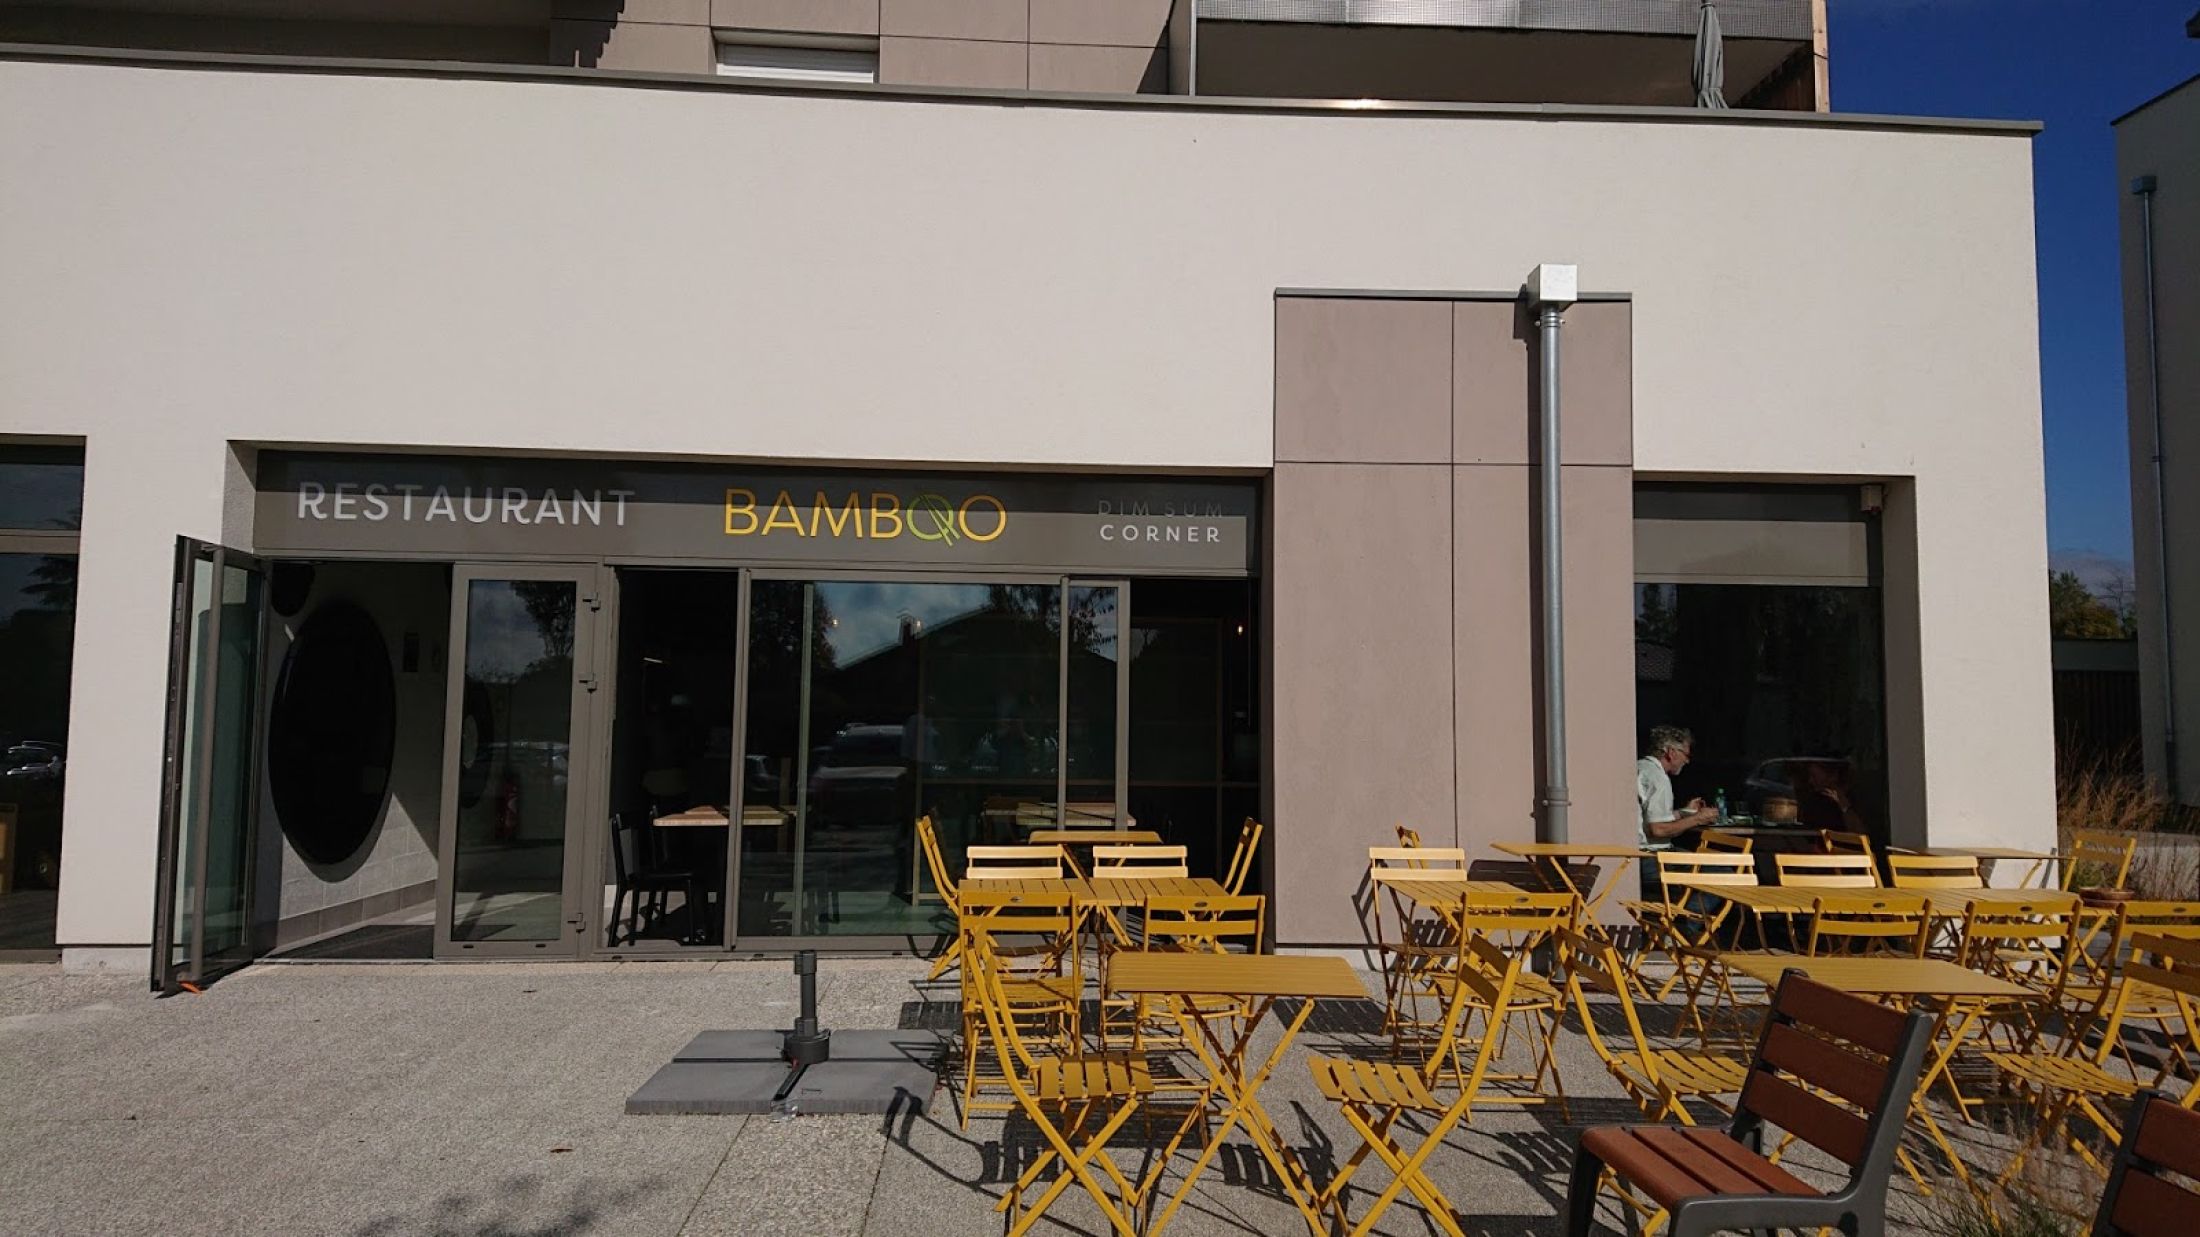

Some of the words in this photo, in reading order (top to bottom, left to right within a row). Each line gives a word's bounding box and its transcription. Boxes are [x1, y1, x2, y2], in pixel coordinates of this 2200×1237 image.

[297, 481, 635, 526] RESTAURANT
[724, 488, 1007, 545] BAMBOO
[1099, 500, 1150, 517] DIM
[1164, 502, 1223, 518] SUM
[1100, 524, 1221, 542] CORNER
